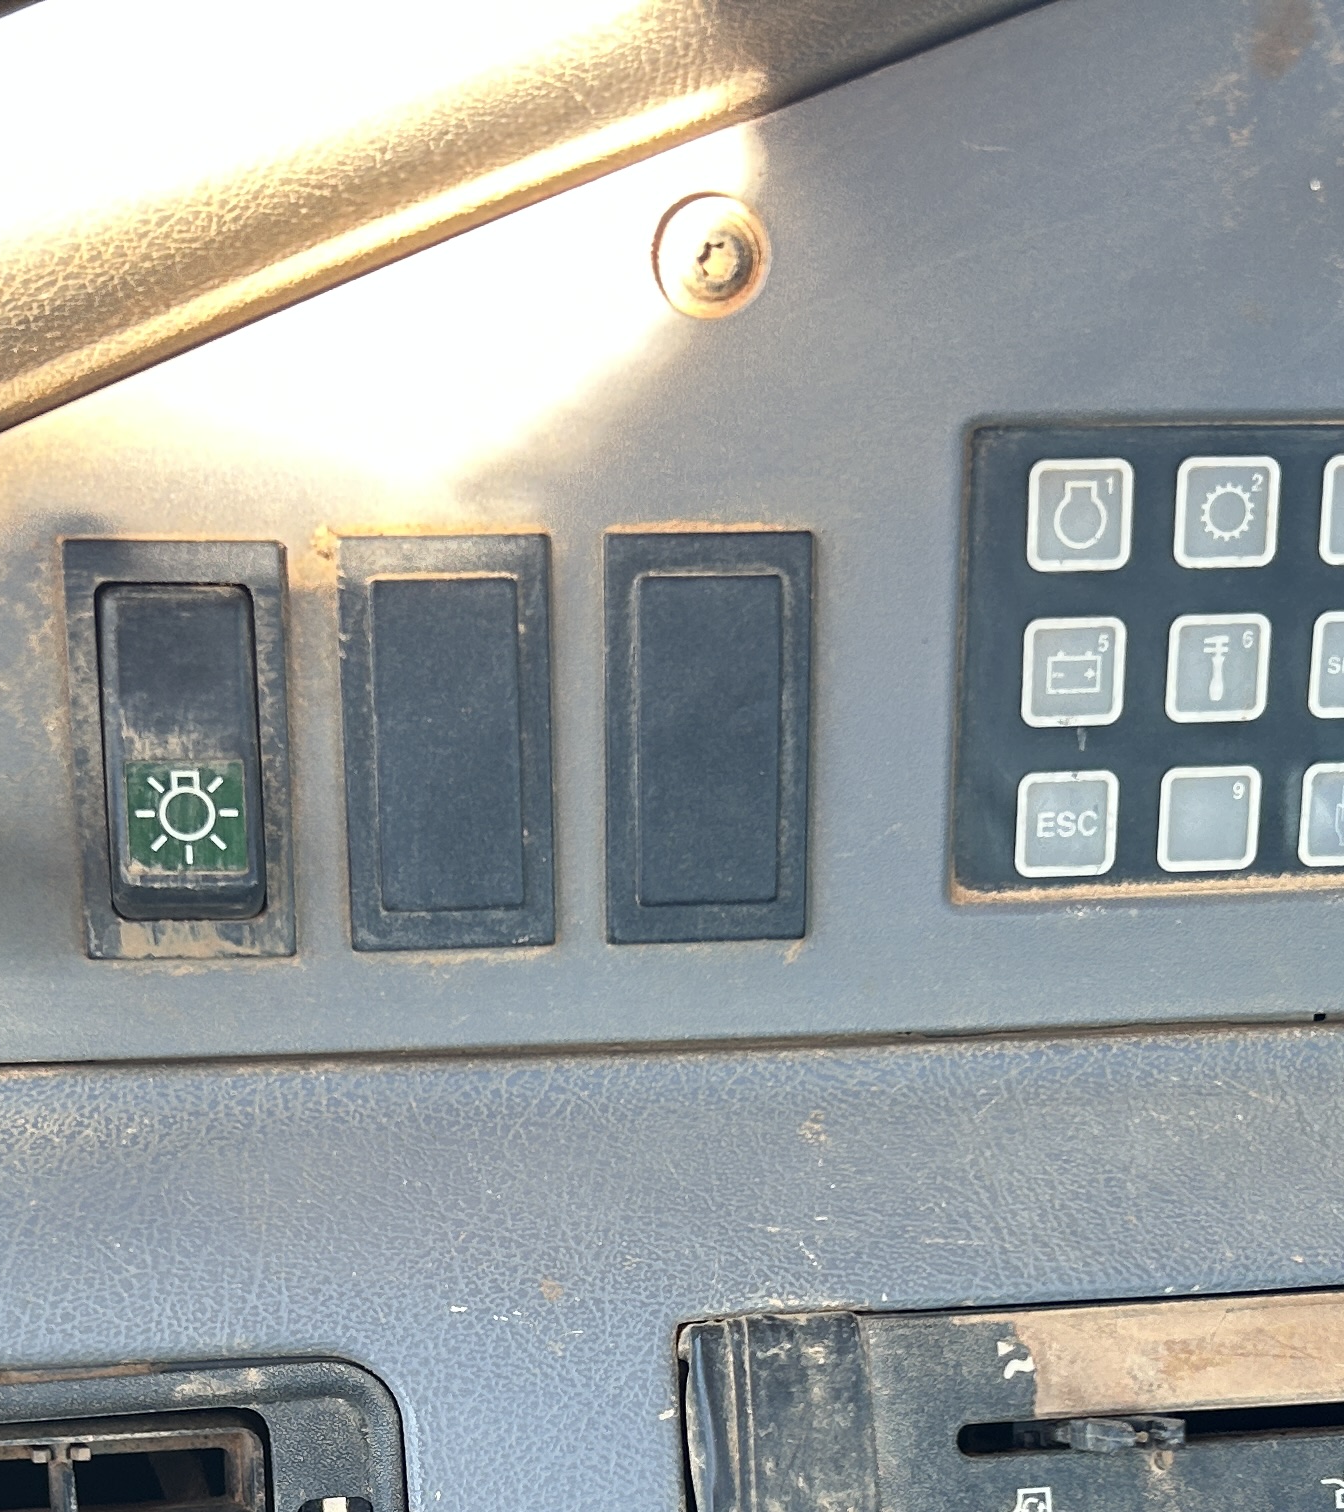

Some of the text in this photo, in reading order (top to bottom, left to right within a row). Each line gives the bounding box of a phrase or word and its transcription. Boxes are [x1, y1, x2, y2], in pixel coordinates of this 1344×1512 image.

[1105, 478, 1115, 495] 1
[1252, 474, 1264, 492] 2
[1097, 634, 1110, 652] 5
[1242, 631, 1254, 649] 6
[1232, 780, 1245, 800] 9
[1036, 809, 1100, 837] ESC
